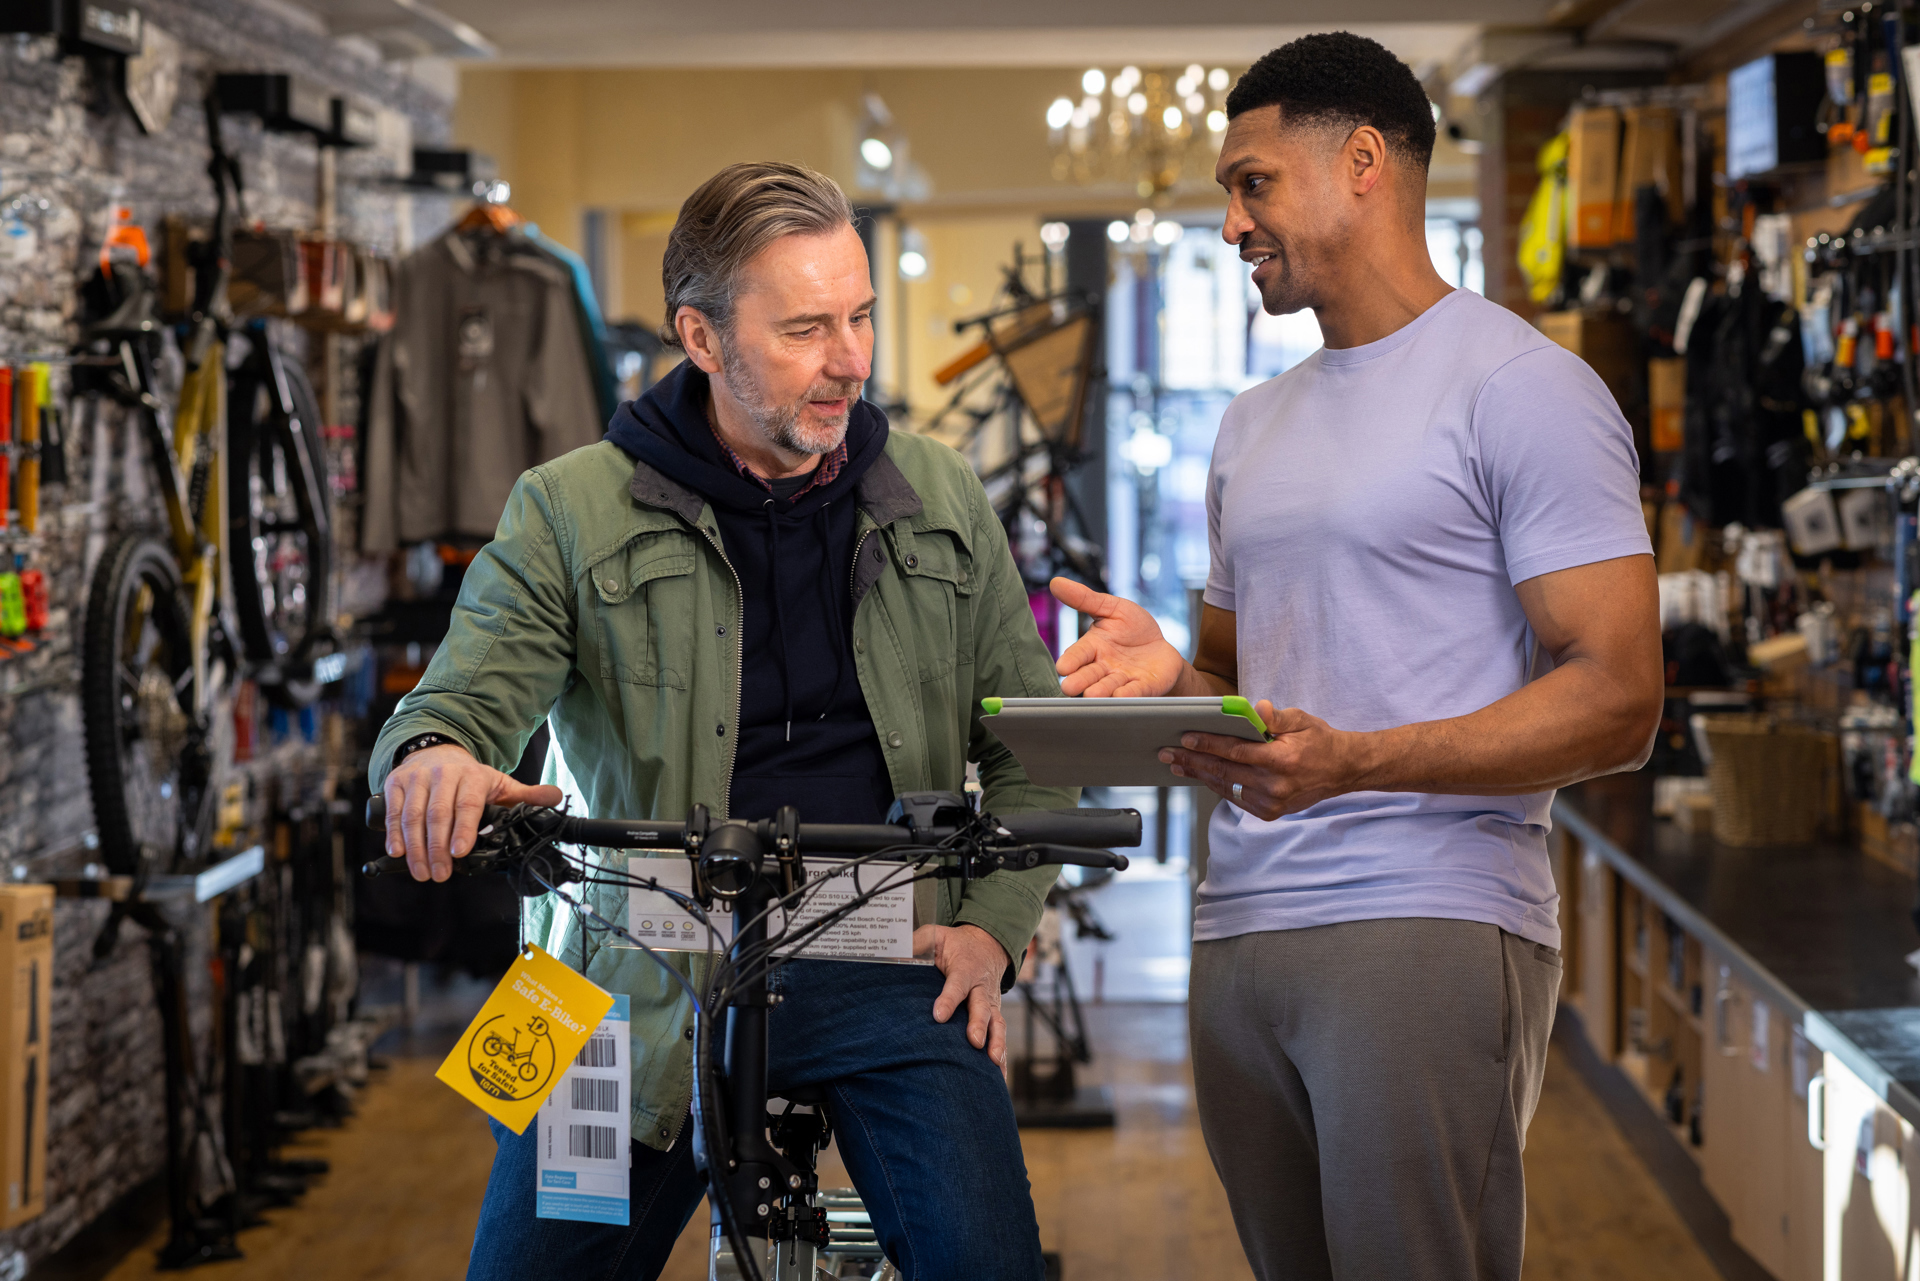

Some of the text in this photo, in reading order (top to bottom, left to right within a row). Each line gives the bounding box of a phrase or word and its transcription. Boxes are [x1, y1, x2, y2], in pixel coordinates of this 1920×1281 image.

[806, 868, 855, 879] rgo ike
[520, 971, 538, 986] What
[537, 983, 559, 1001] Makes
[512, 979, 587, 1035] Safe E-Bike?
[477, 1062, 518, 1094] for Safety
[489, 1059, 518, 1083] Tested
